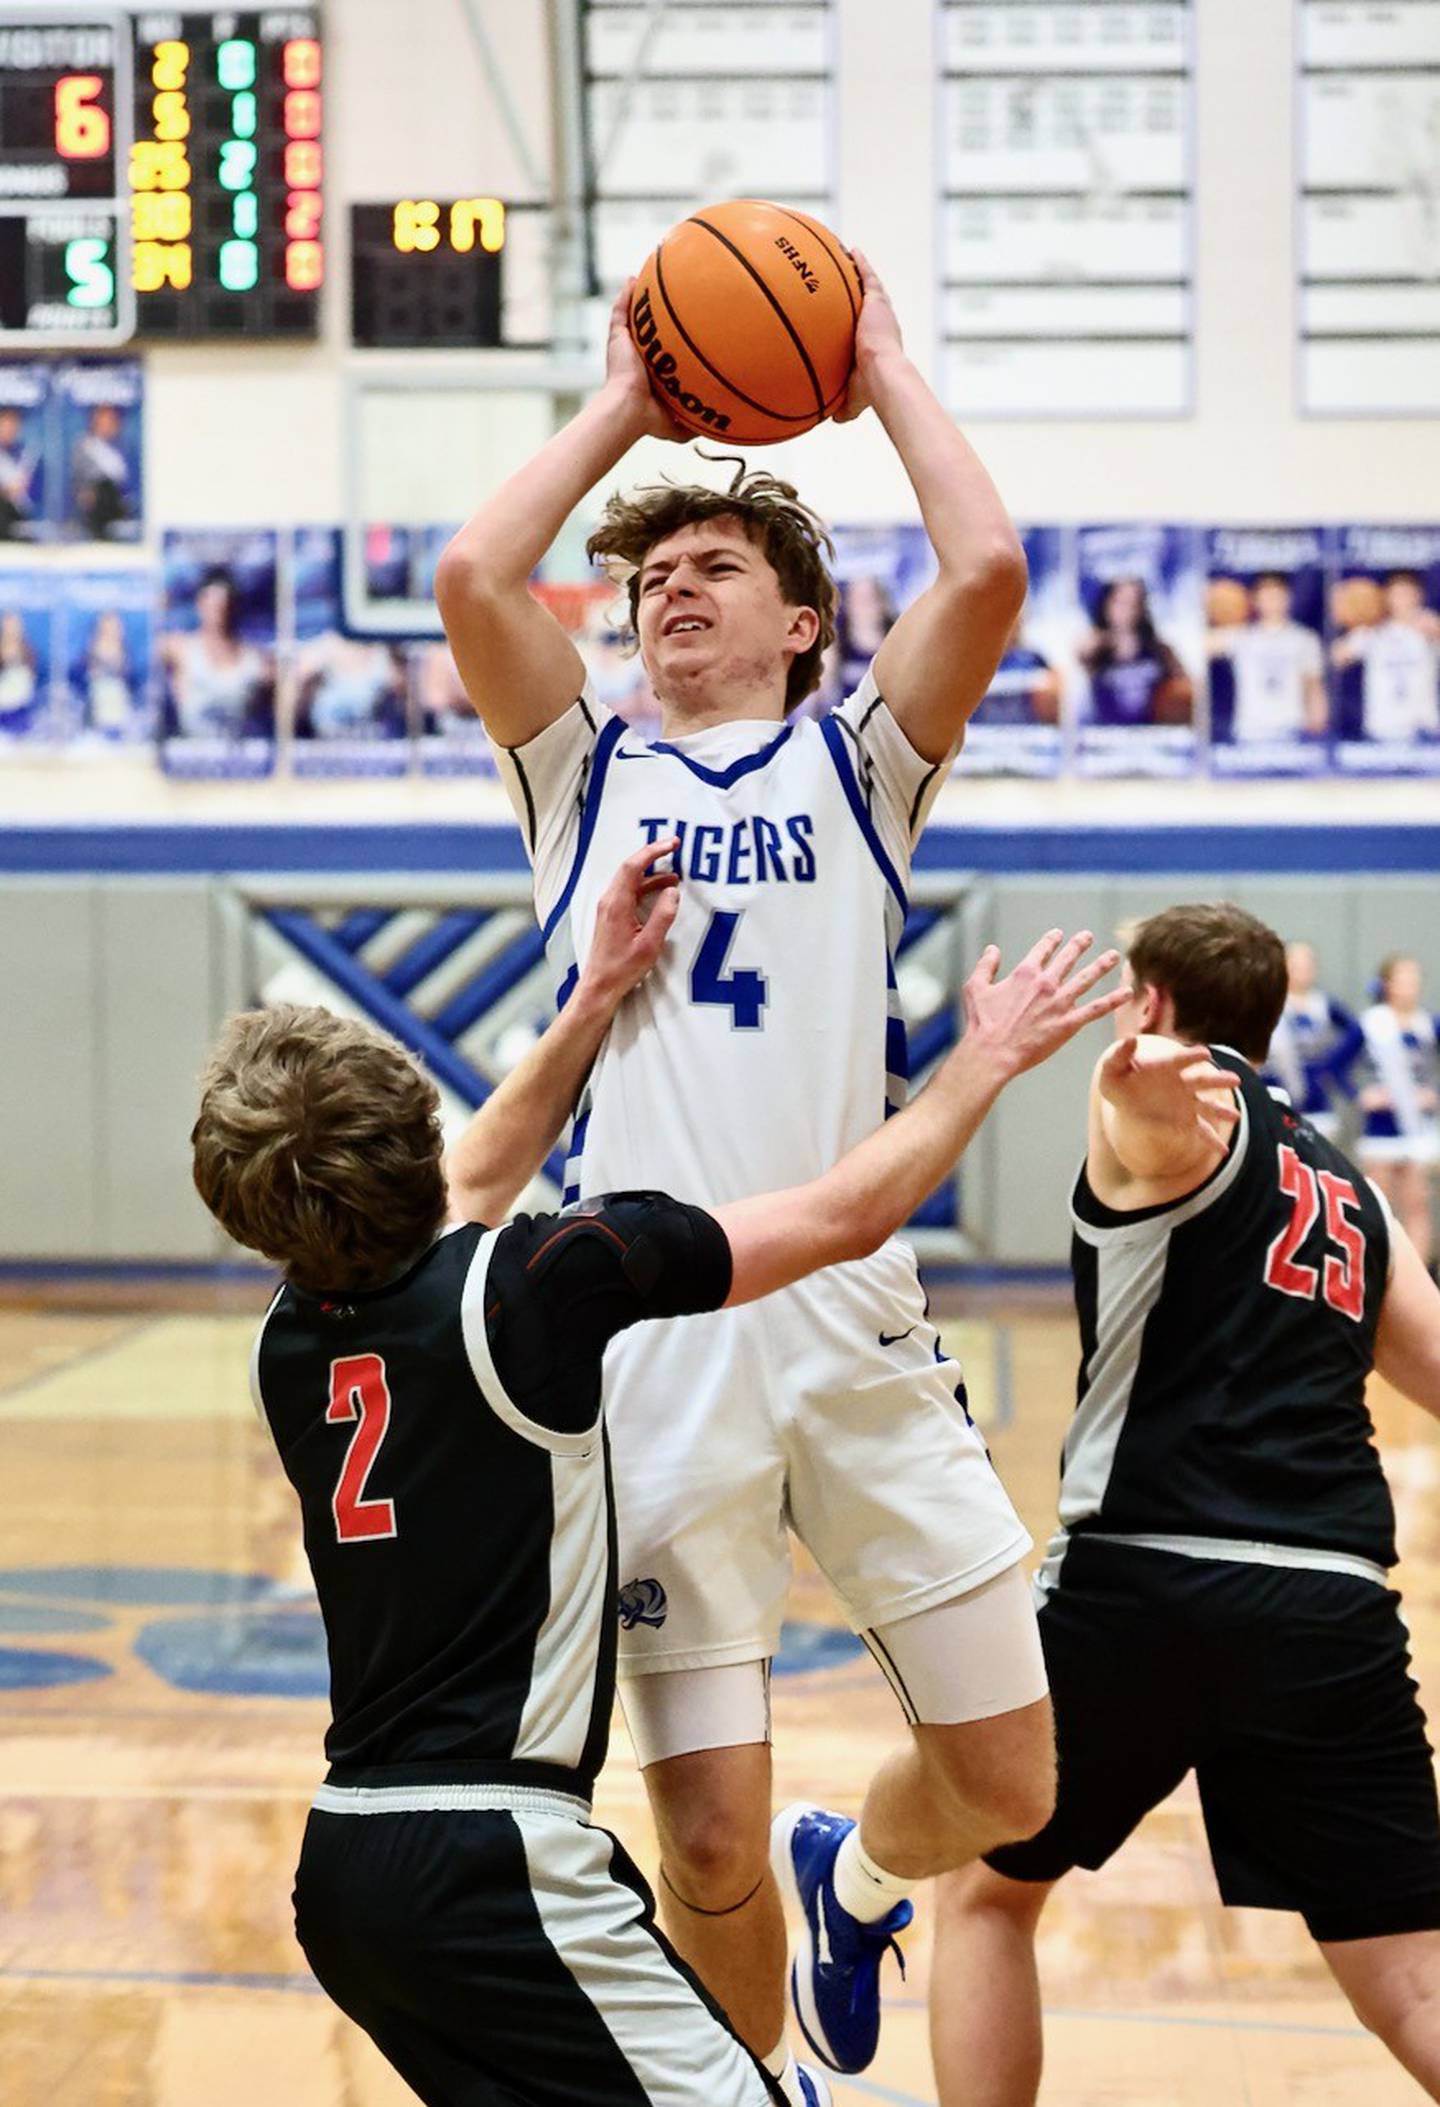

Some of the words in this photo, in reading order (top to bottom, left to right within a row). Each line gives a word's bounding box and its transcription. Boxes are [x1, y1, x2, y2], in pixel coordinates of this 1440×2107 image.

[153, 40, 189, 90] 2
[55, 76, 110, 158] 6
[153, 91, 190, 140] 5
[233, 91, 256, 138] 1
[219, 140, 257, 190] 2
[234, 191, 257, 238] 1
[285, 190, 323, 240] 2
[65, 238, 114, 307] 5
[775, 236, 813, 280] NFHS
[633, 287, 732, 431] Wilson
[639, 814, 817, 885] TIGERS
[687, 907, 769, 1032] 4
[1263, 1142, 1366, 1323] 25
[325, 1353, 398, 1543] 2
